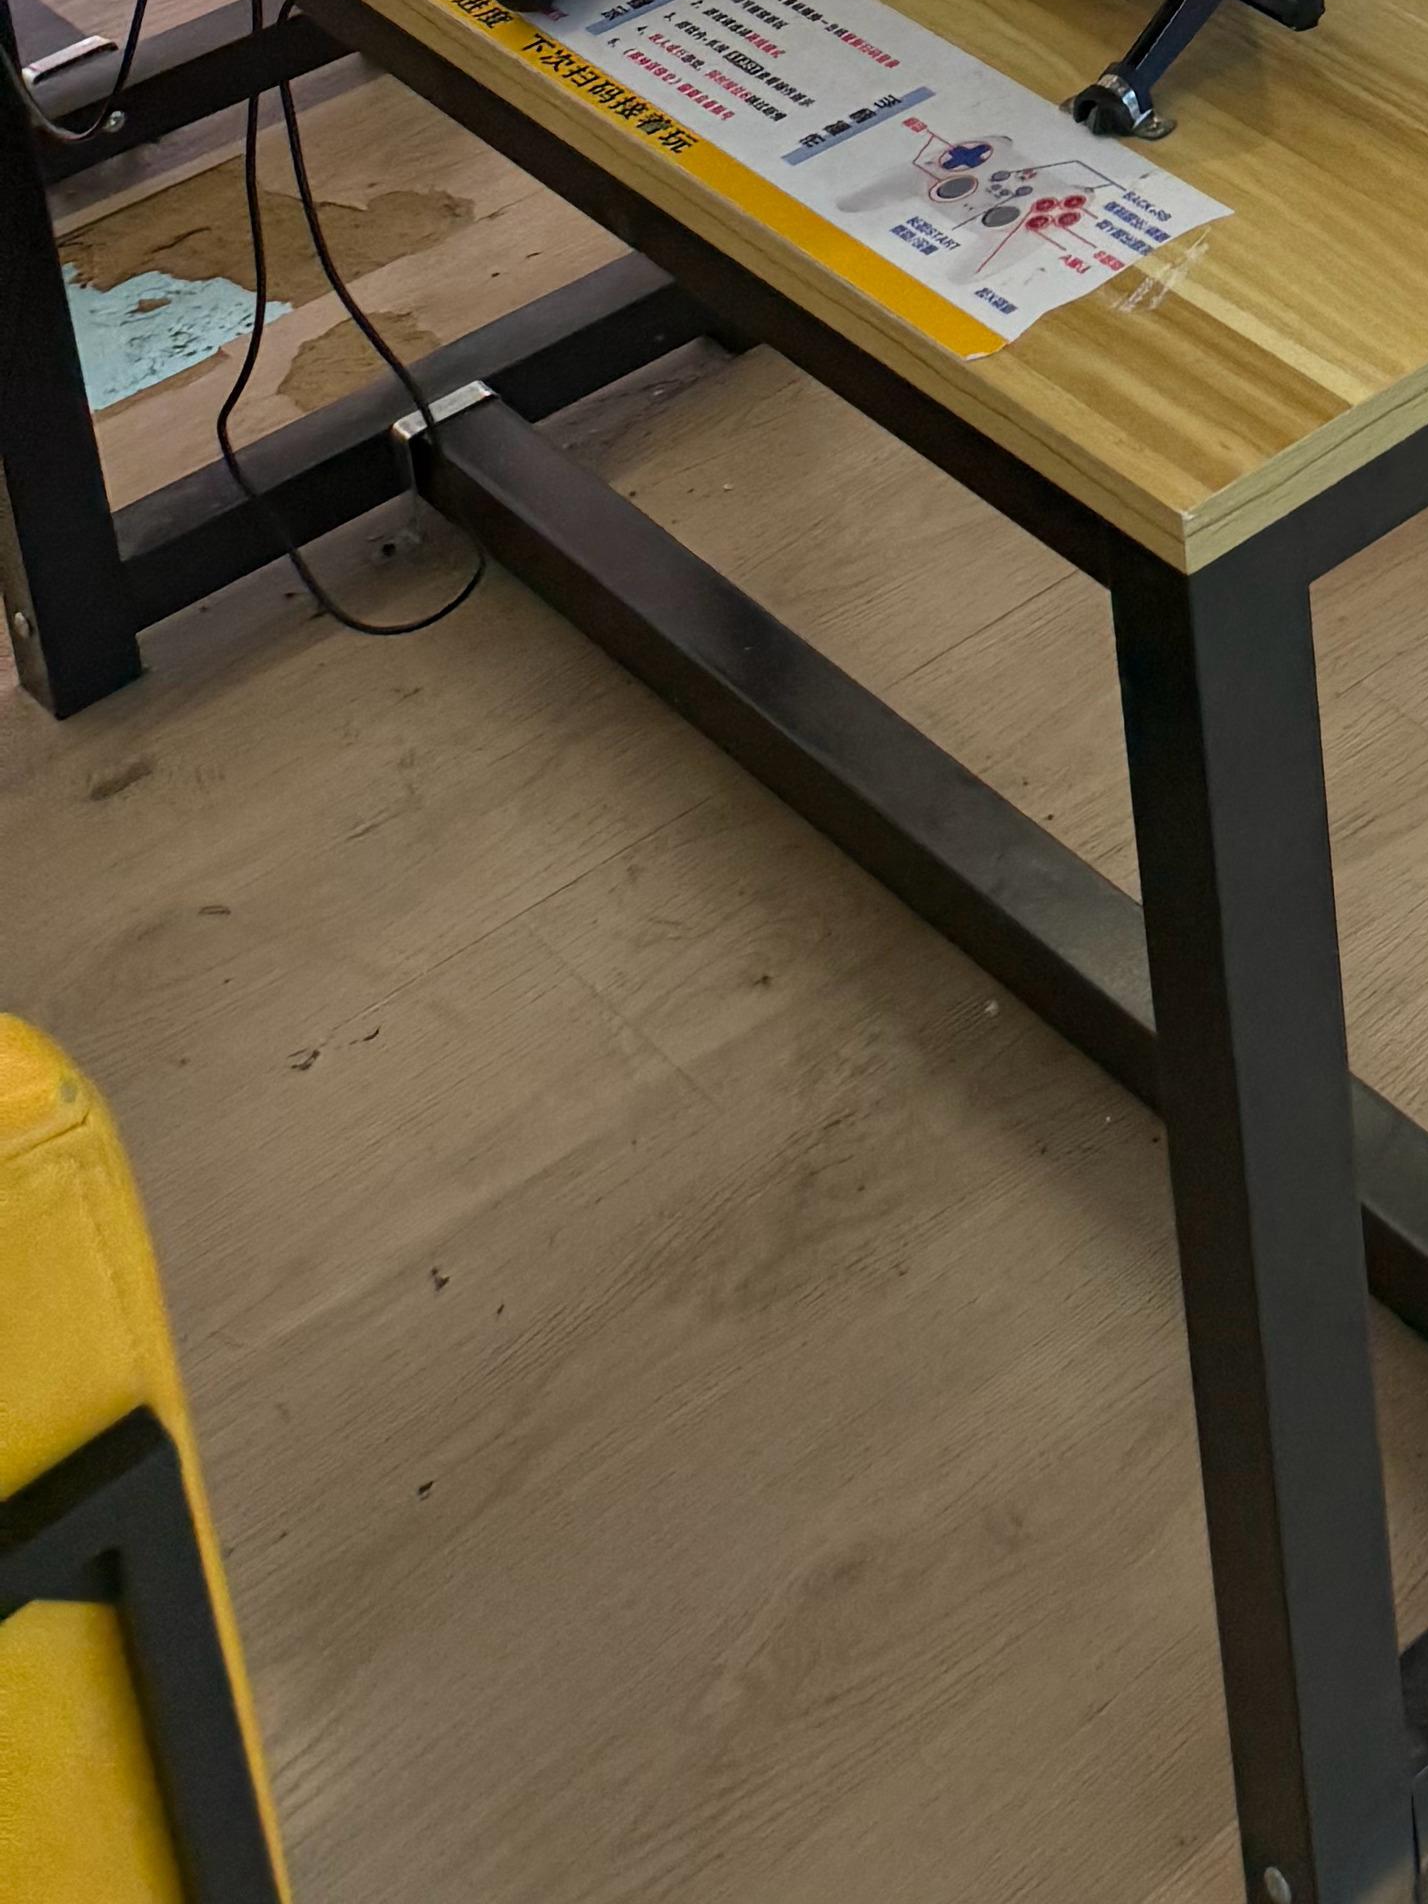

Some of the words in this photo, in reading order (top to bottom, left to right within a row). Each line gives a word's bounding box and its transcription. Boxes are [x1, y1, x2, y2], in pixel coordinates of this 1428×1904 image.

[522, 31, 700, 155] 下次扫码接着玩
